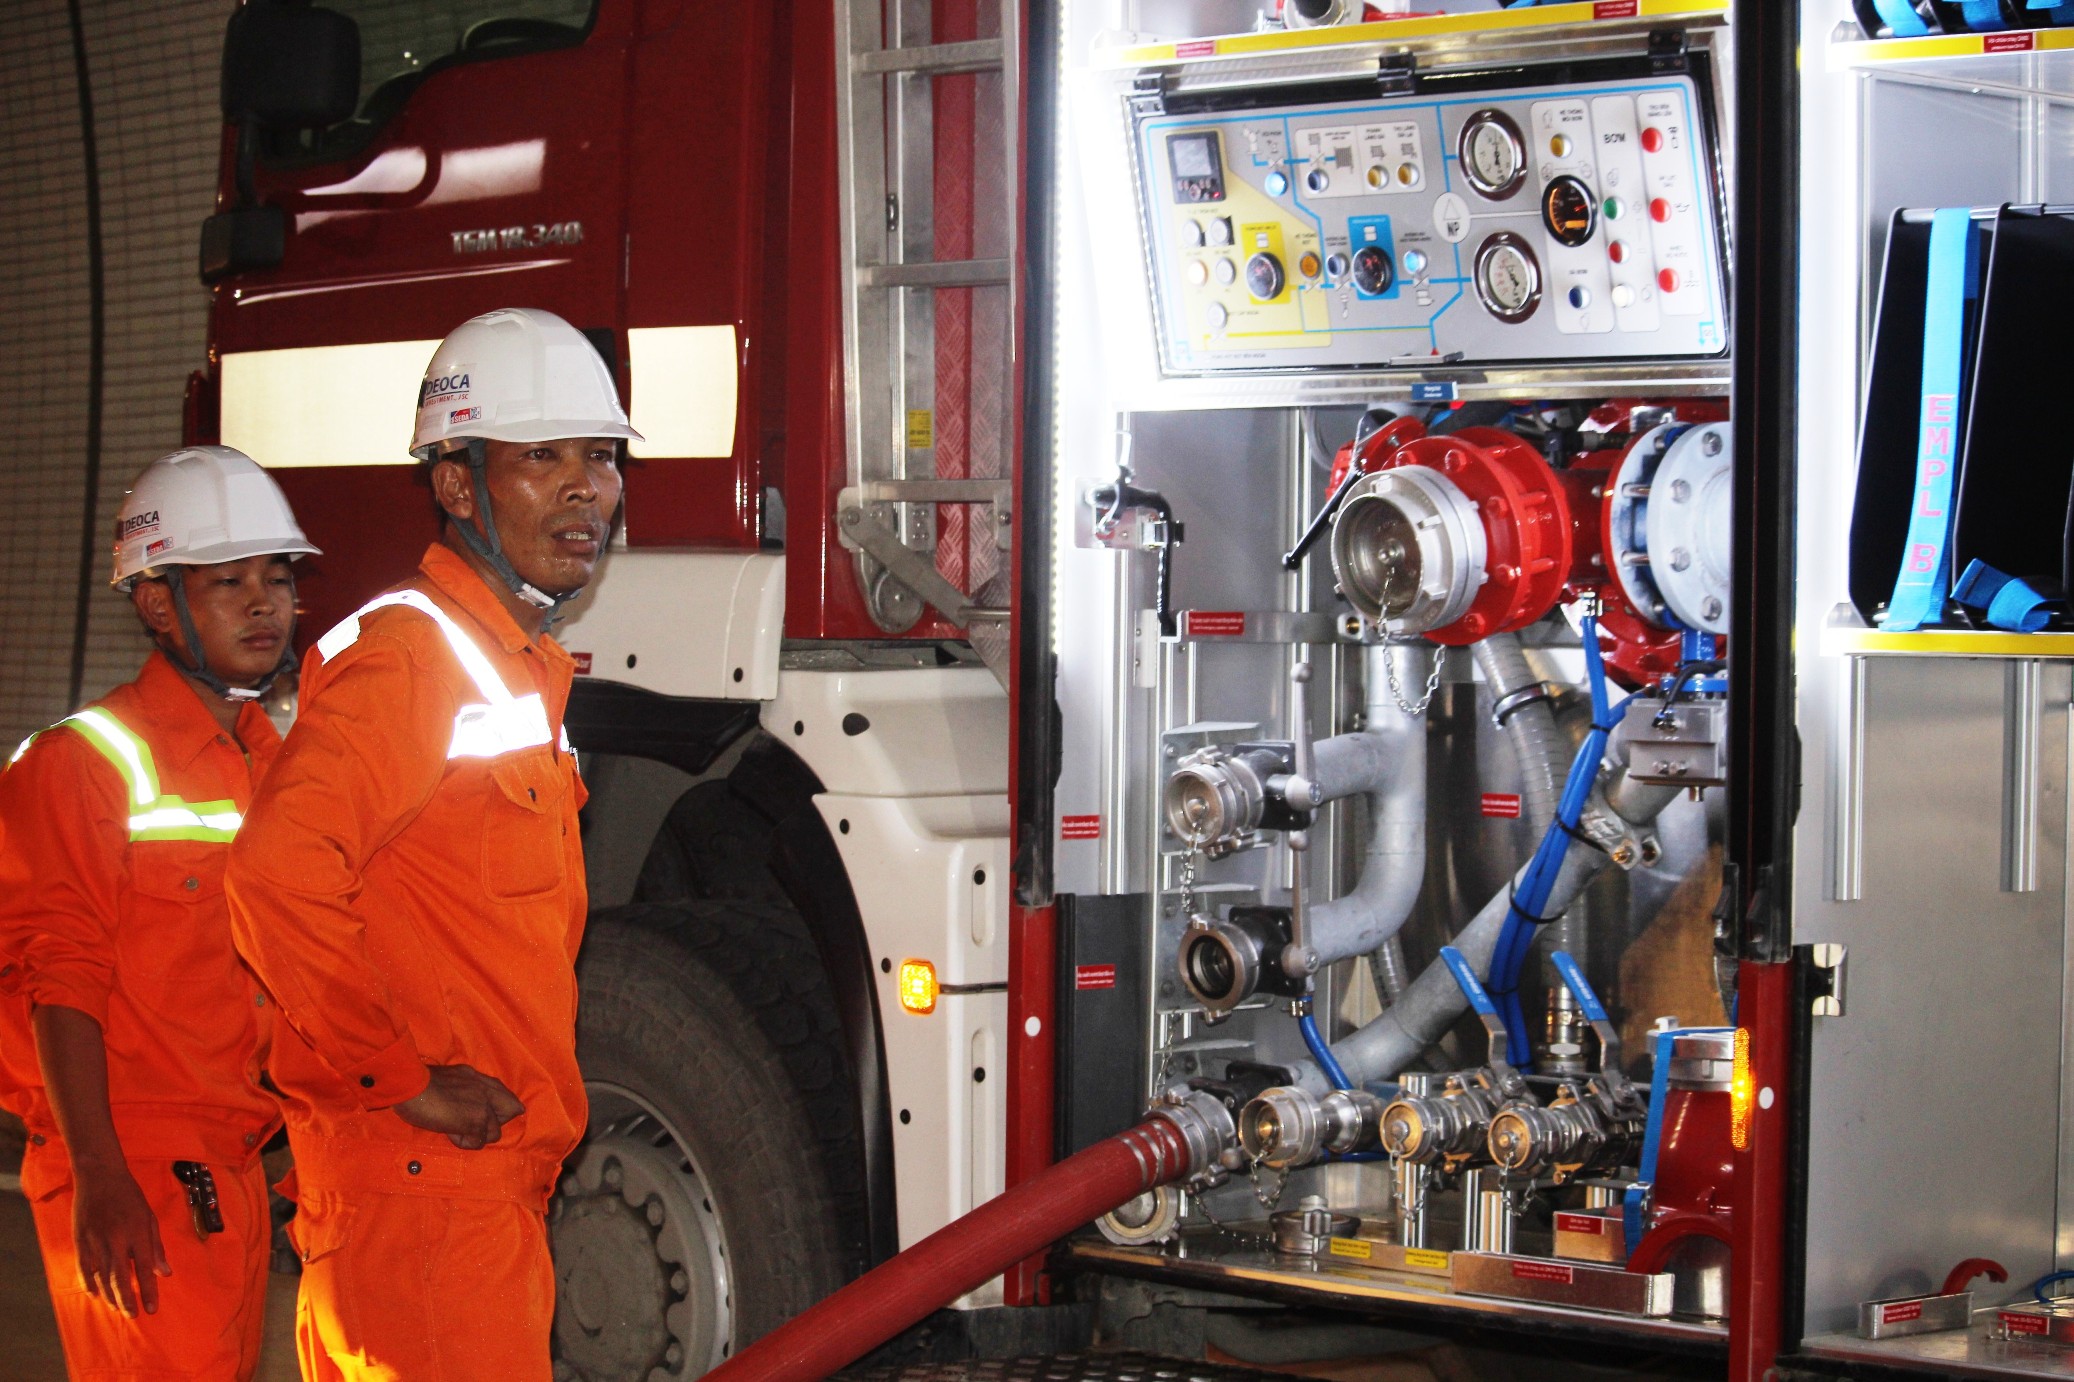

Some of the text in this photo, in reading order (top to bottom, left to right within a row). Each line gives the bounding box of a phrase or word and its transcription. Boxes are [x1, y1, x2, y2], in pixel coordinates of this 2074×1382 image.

[451, 229, 497, 254] TGM
[426, 374, 470, 396] DEOCA
[1918, 396, 1954, 517] EMPL
[125, 510, 160, 531] DEOCA
